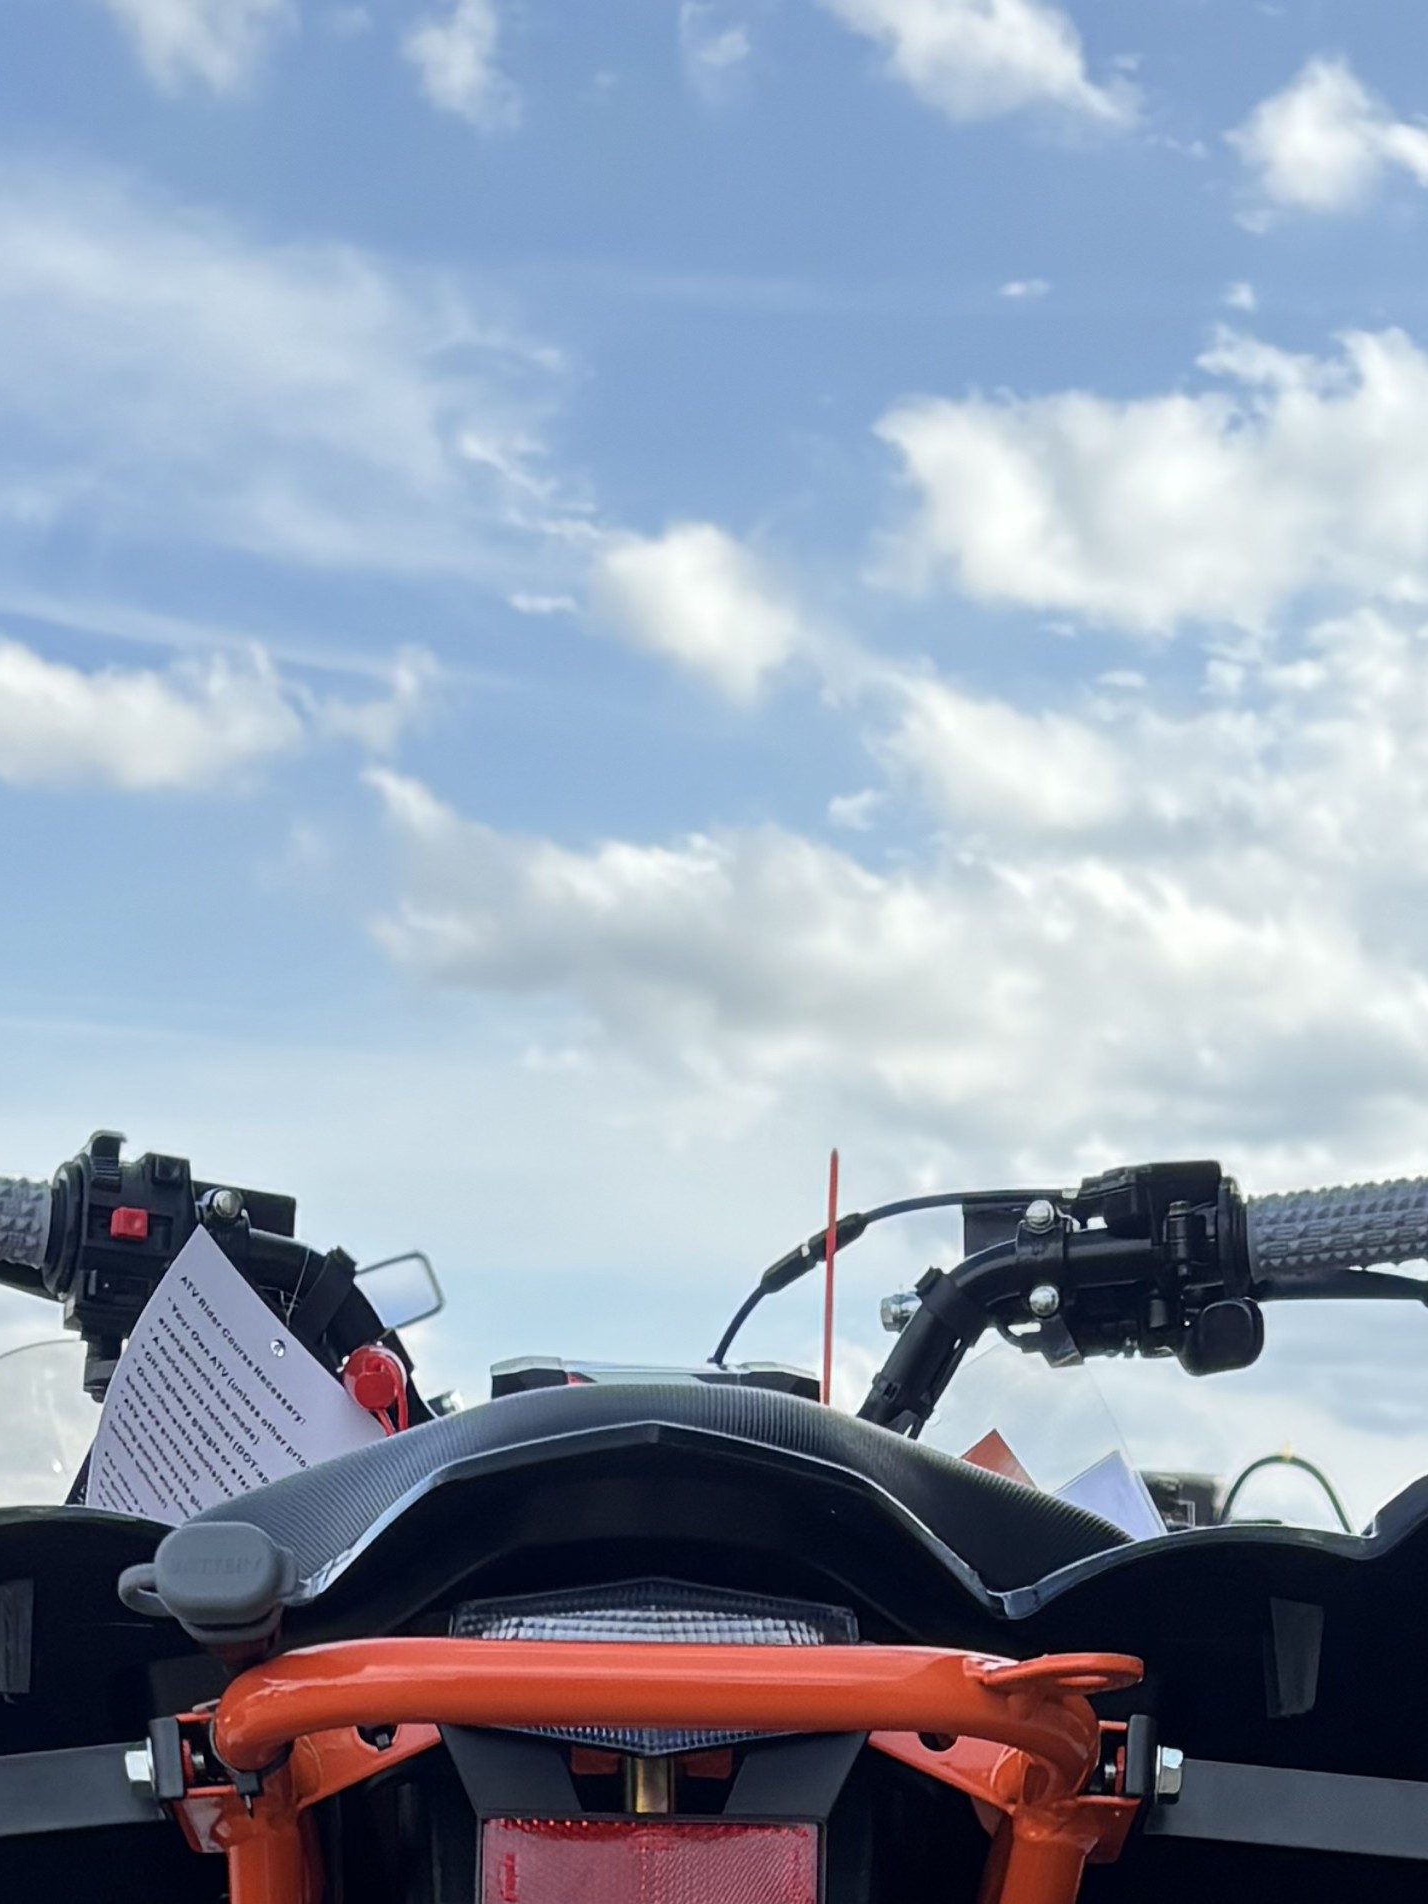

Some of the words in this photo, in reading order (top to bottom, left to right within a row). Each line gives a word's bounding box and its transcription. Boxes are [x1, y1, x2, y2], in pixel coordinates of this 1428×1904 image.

[158, 1317, 214, 1391] arrangements
[230, 1411, 260, 1445] made)
[171, 1302, 190, 1330] Your
[190, 1330, 210, 1356] Own
[208, 1355, 228, 1377] ATV
[226, 1377, 260, 1418] (unless
[260, 1418, 287, 1445] other
[179, 1275, 199, 1297] ATV
[197, 1297, 222, 1327] Rider
[221, 1327, 253, 1367] Course
[253, 1365, 306, 1424] Necessary:
